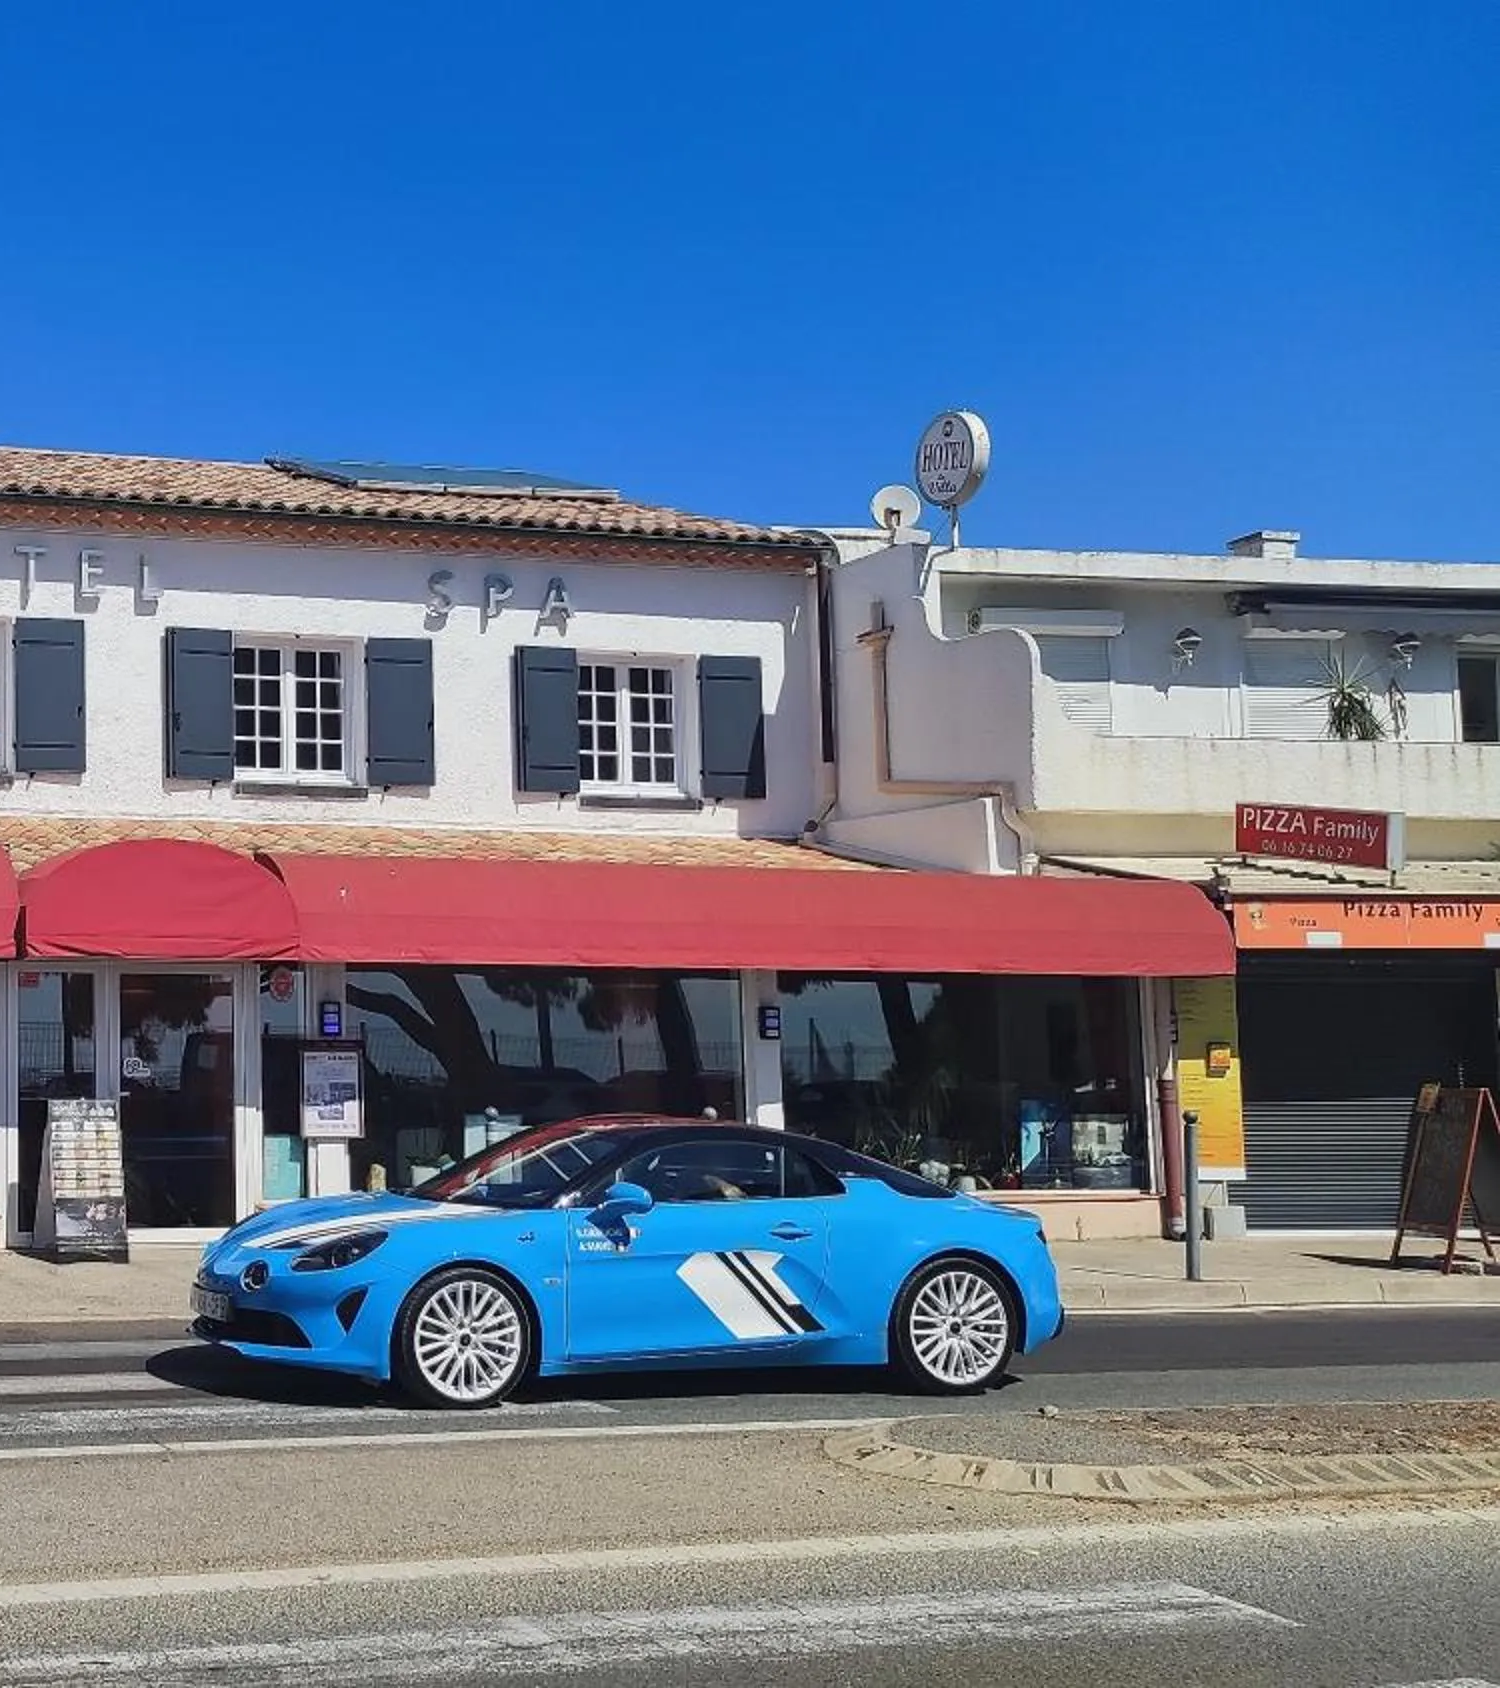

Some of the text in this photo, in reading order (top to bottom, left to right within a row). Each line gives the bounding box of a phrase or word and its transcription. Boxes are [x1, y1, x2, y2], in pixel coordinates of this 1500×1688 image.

[922, 441, 968, 472] HOTEL
[428, 570, 574, 618] SPA
[1242, 807, 1379, 847] PIZZA Family
[1342, 900, 1401, 918] Pizza
[1411, 900, 1483, 922] Family
